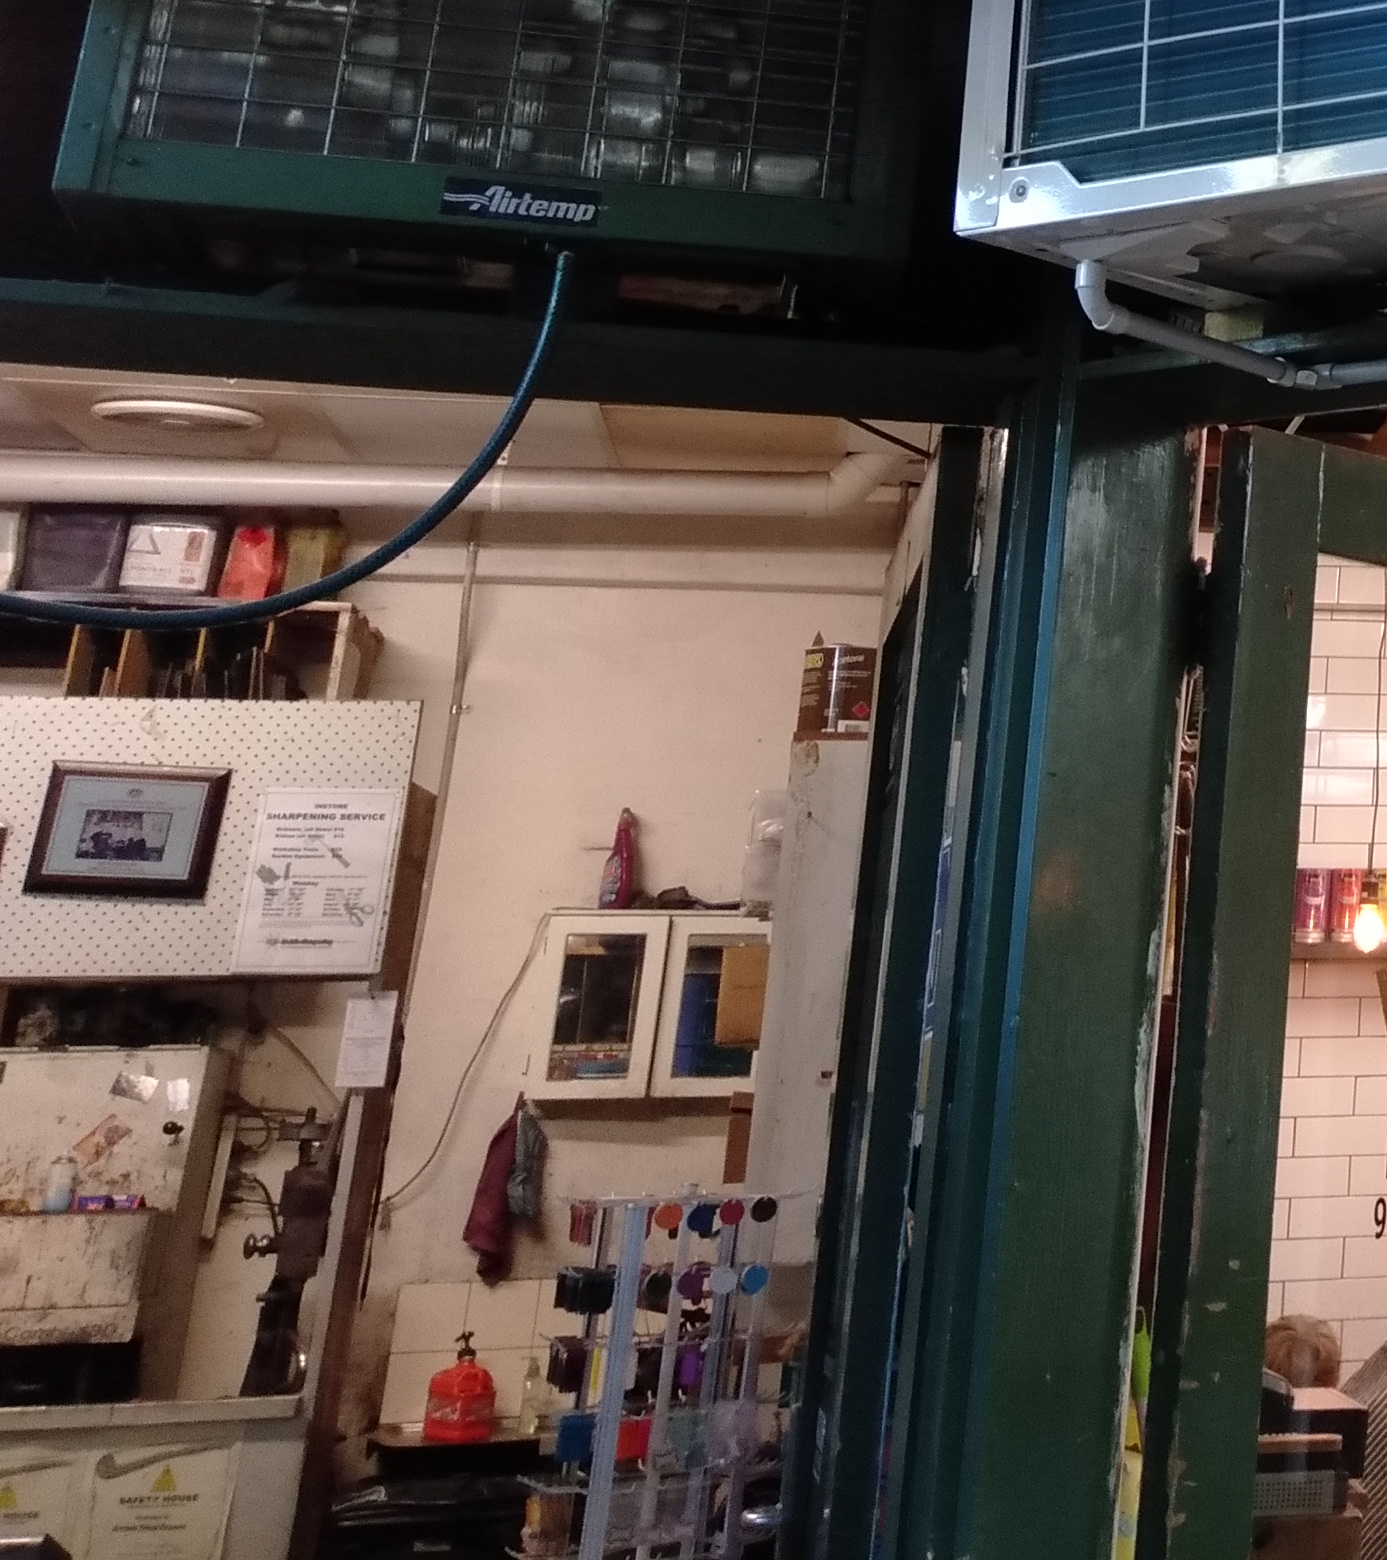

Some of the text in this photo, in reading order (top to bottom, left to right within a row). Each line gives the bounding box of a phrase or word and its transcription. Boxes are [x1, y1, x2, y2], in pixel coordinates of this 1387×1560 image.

[467, 185, 597, 222] Airtemp
[266, 813, 386, 821] SHARPENING SERVICE
